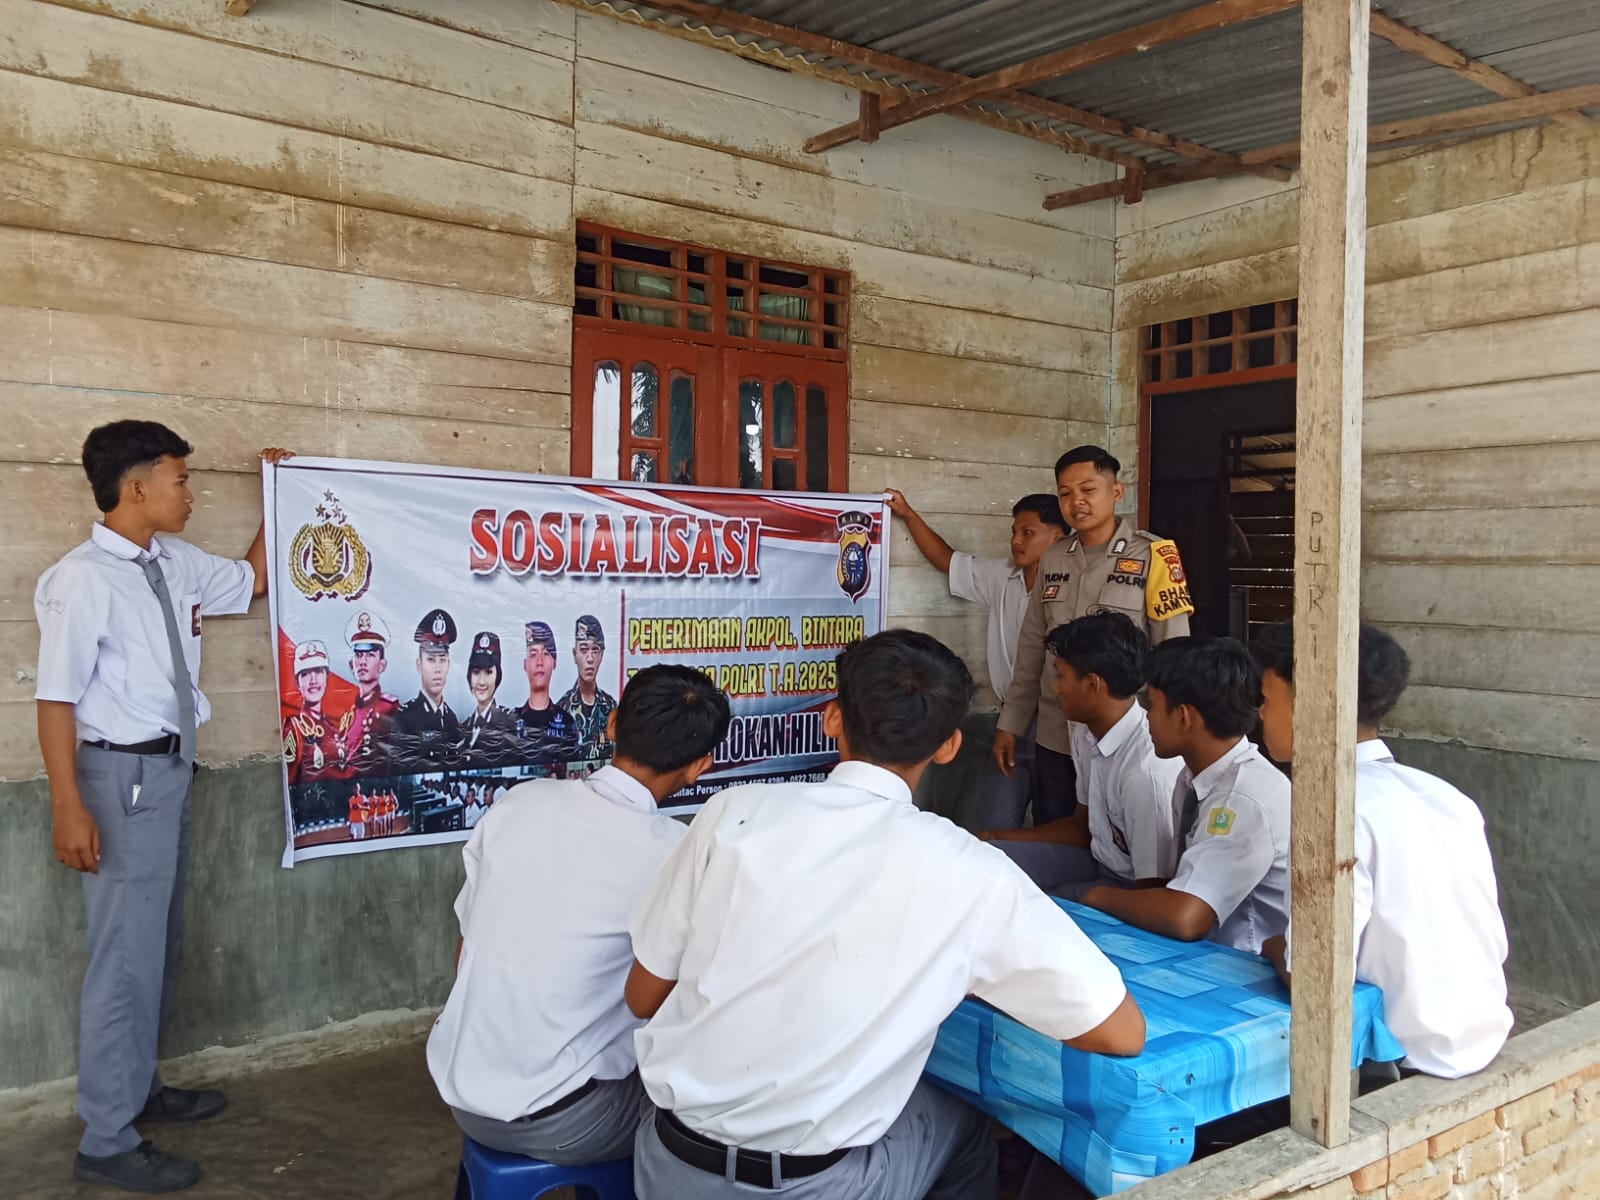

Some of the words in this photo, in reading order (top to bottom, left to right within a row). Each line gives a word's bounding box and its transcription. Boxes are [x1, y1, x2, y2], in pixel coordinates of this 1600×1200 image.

[469, 508, 761, 578] SOSIALISASI
[629, 617, 742, 652] PENERIMAAN
[744, 616, 799, 650] AKPOL,
[720, 663, 766, 696] POLRI
[789, 711, 839, 757] HILI
